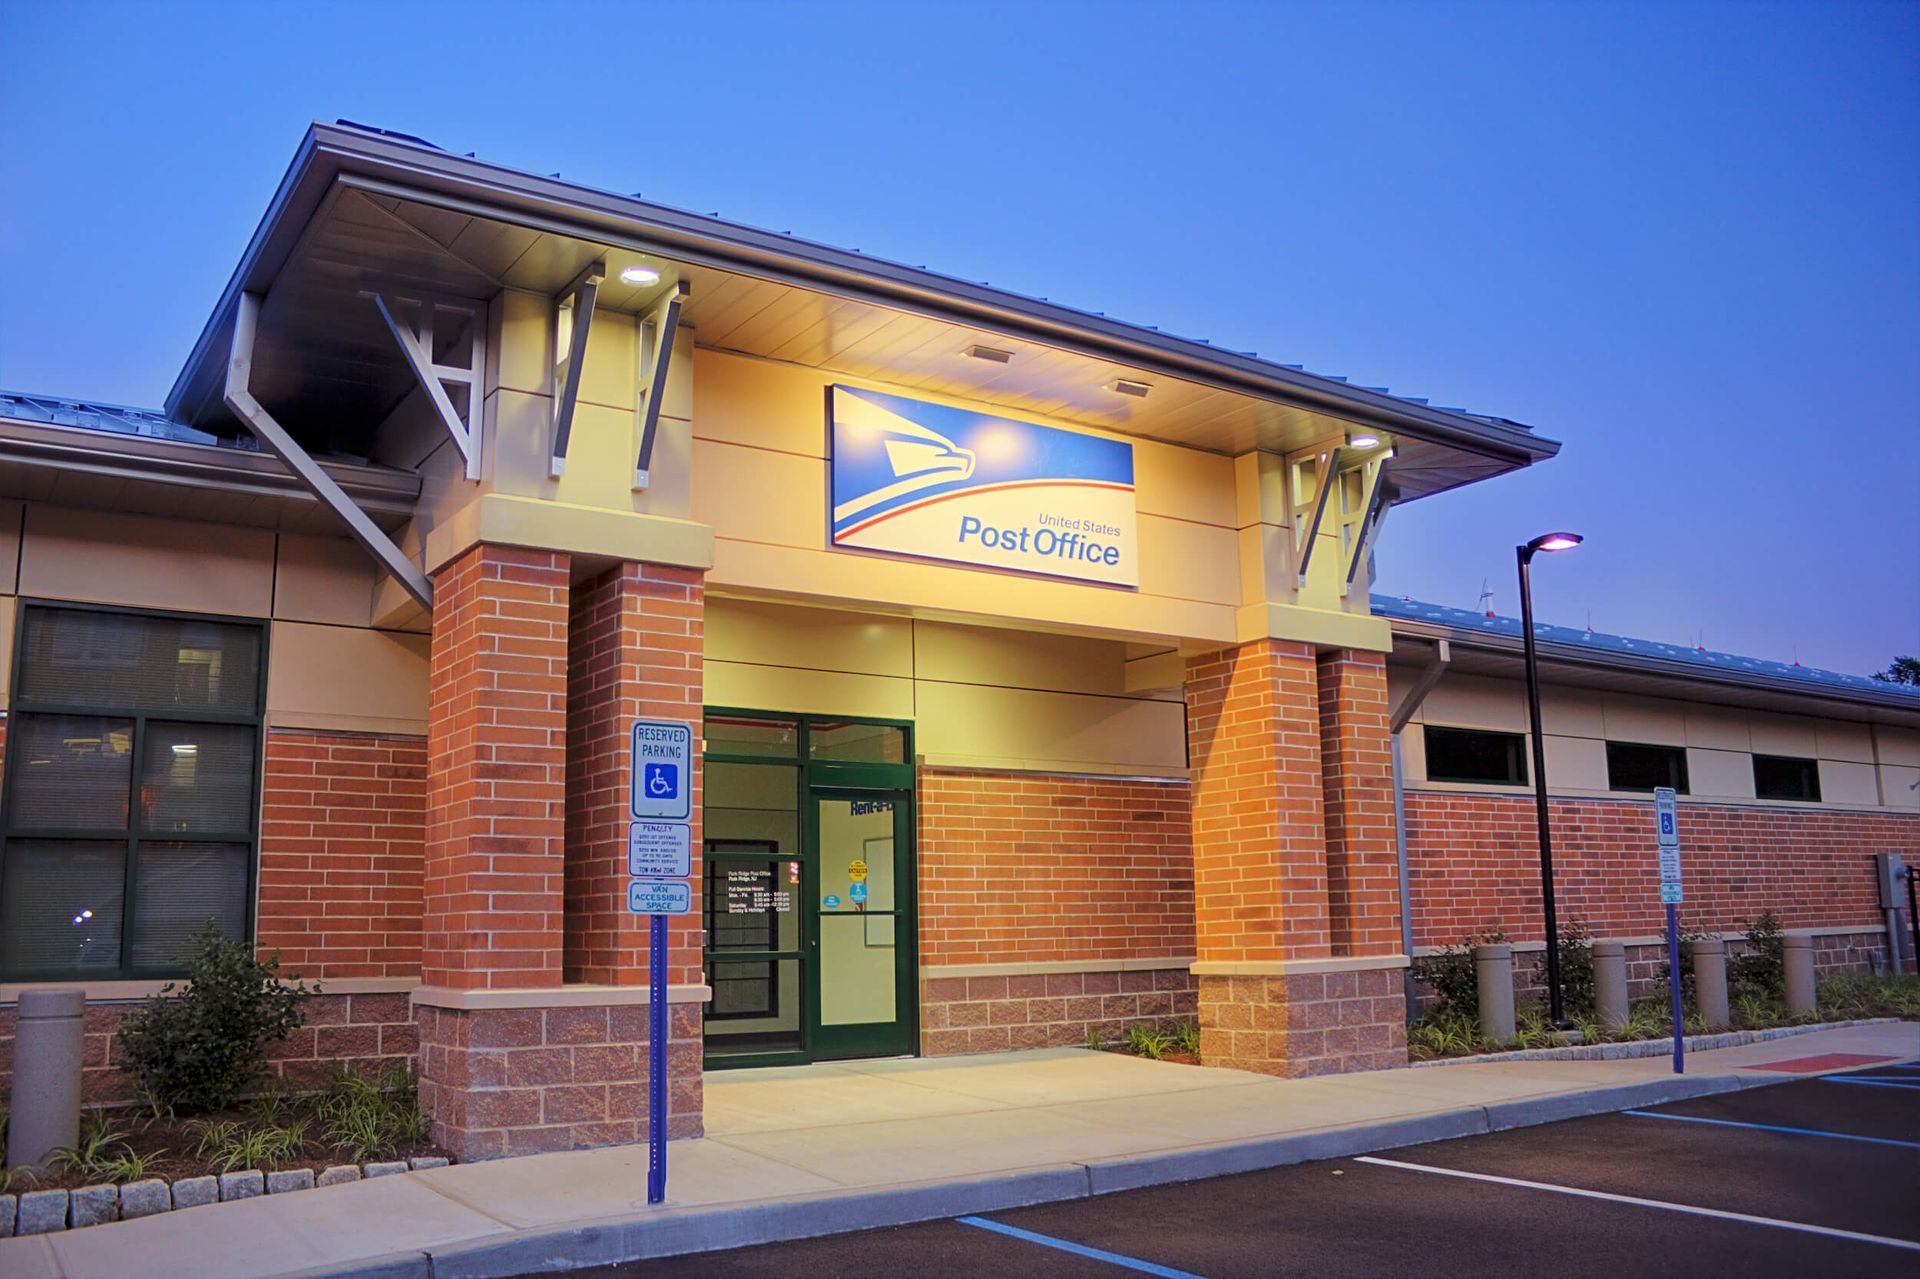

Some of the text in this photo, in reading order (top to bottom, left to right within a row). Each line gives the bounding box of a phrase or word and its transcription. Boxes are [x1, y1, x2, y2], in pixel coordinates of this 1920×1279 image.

[1039, 513, 1121, 537] United States
[959, 516, 1120, 566] Post Office
[638, 728, 685, 742] RESERVED
[642, 744, 681, 758] PARKING
